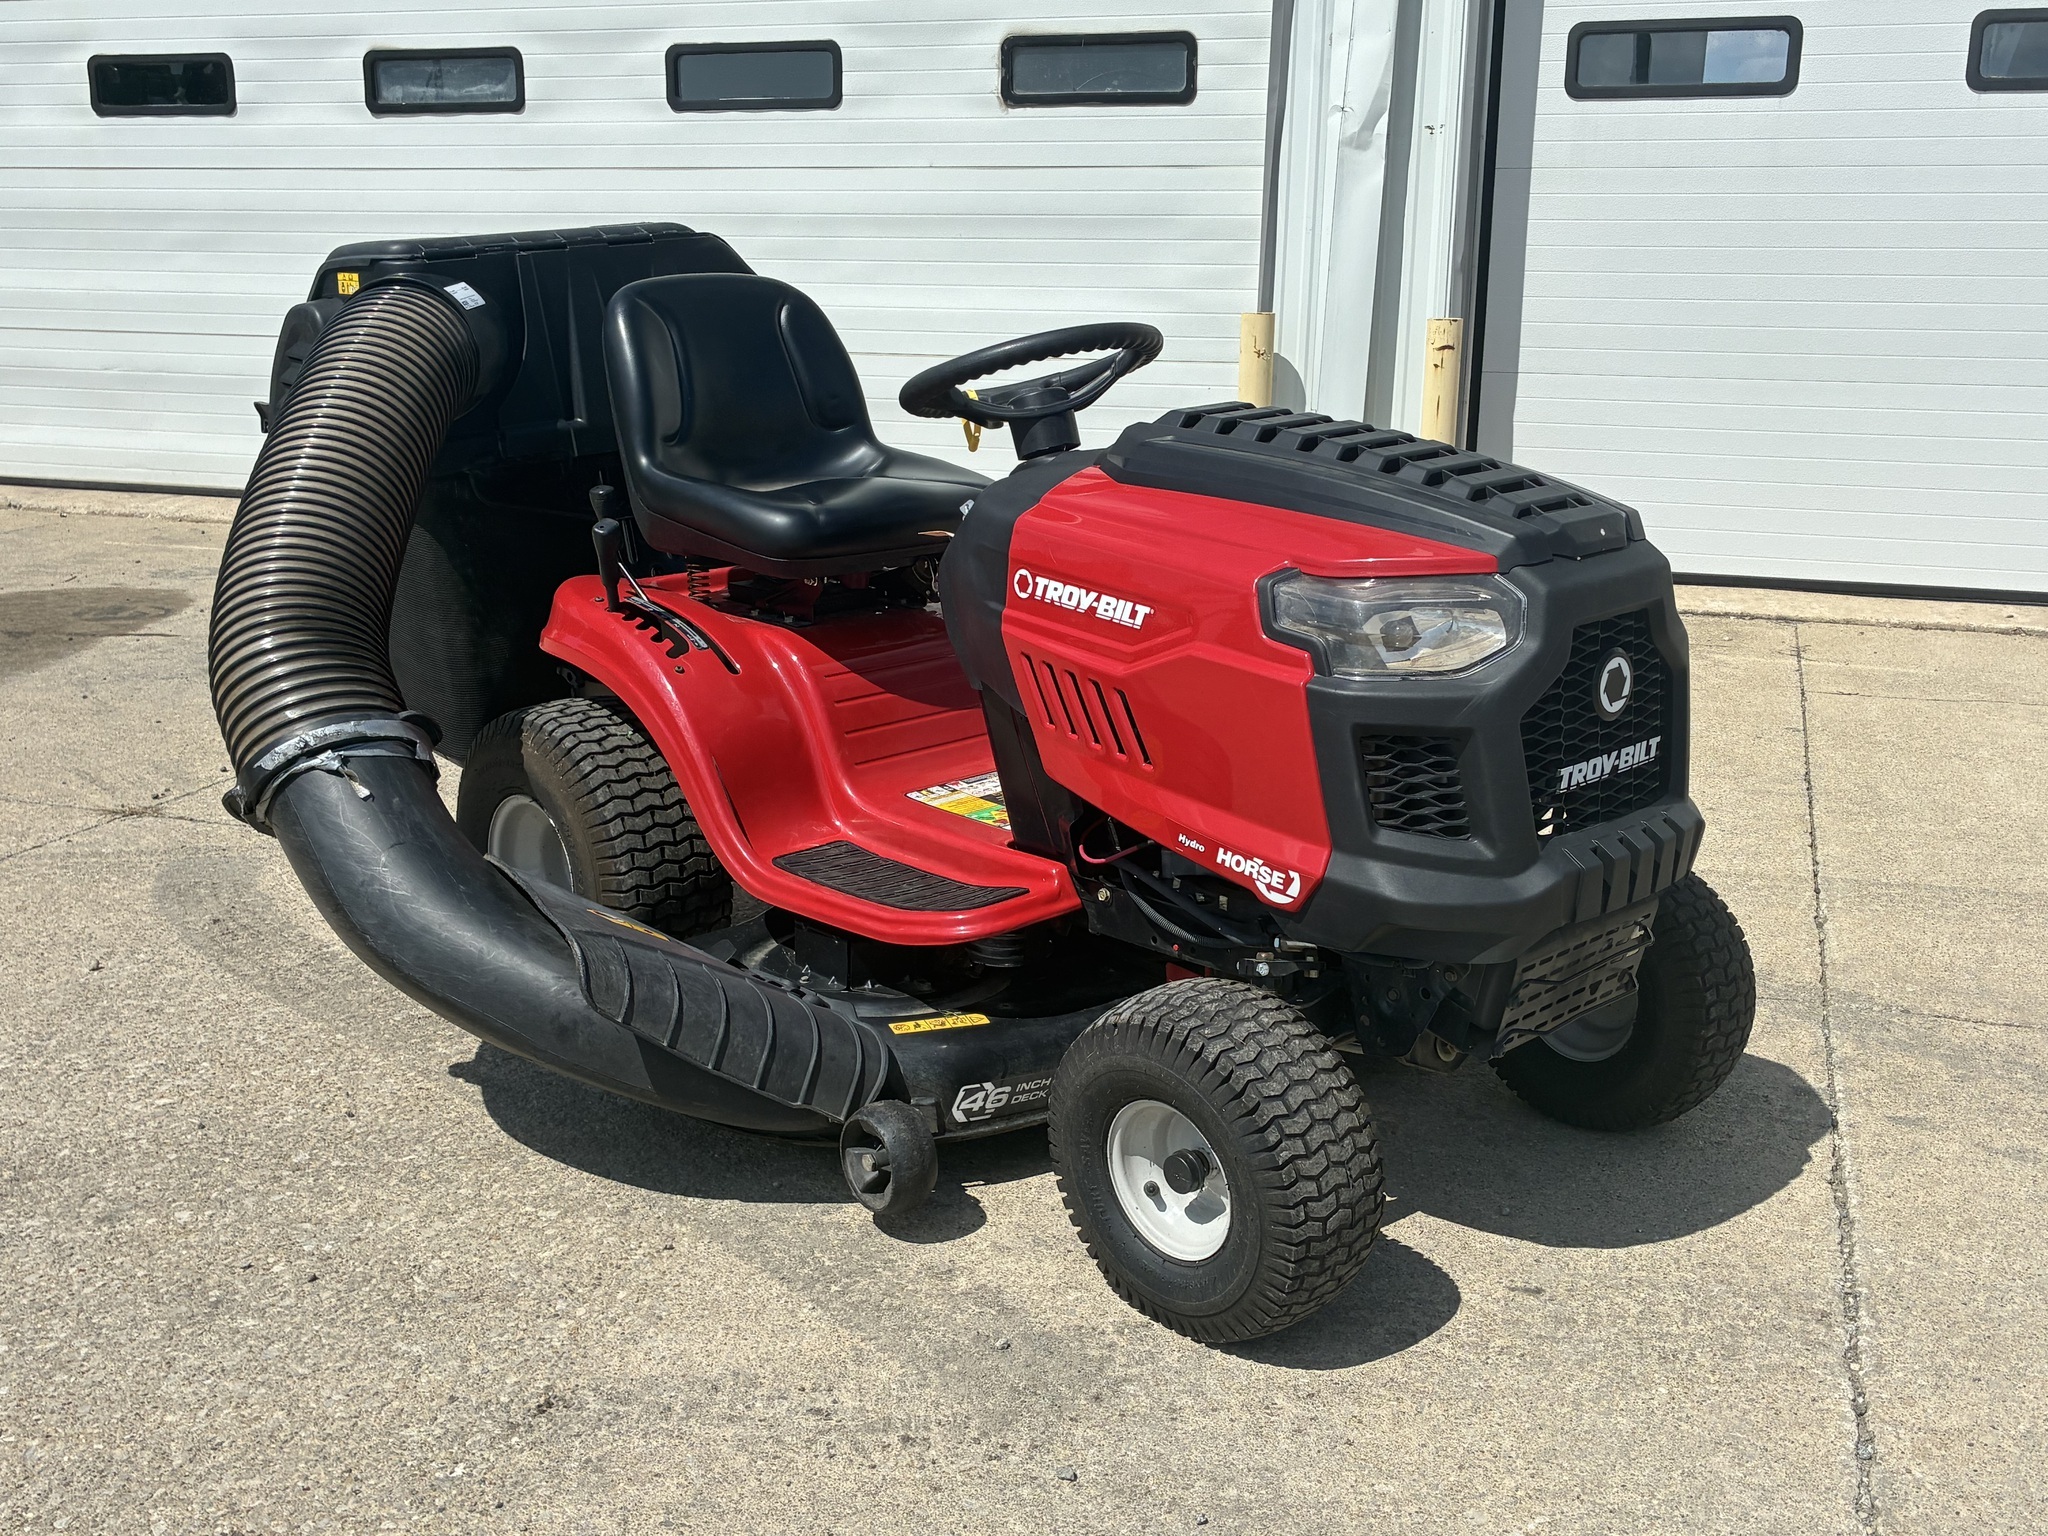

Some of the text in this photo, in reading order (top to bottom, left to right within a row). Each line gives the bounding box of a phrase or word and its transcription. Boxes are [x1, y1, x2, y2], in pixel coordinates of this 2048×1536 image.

[1034, 576, 1151, 630] TROY-BILT
[1559, 736, 1661, 793] TROY-BILT
[1178, 833, 1286, 890] Hydro HORSE
[959, 1086, 1012, 1112] 46
[1011, 1089, 1049, 1105] DECK
[1015, 1077, 1051, 1093] INCH
